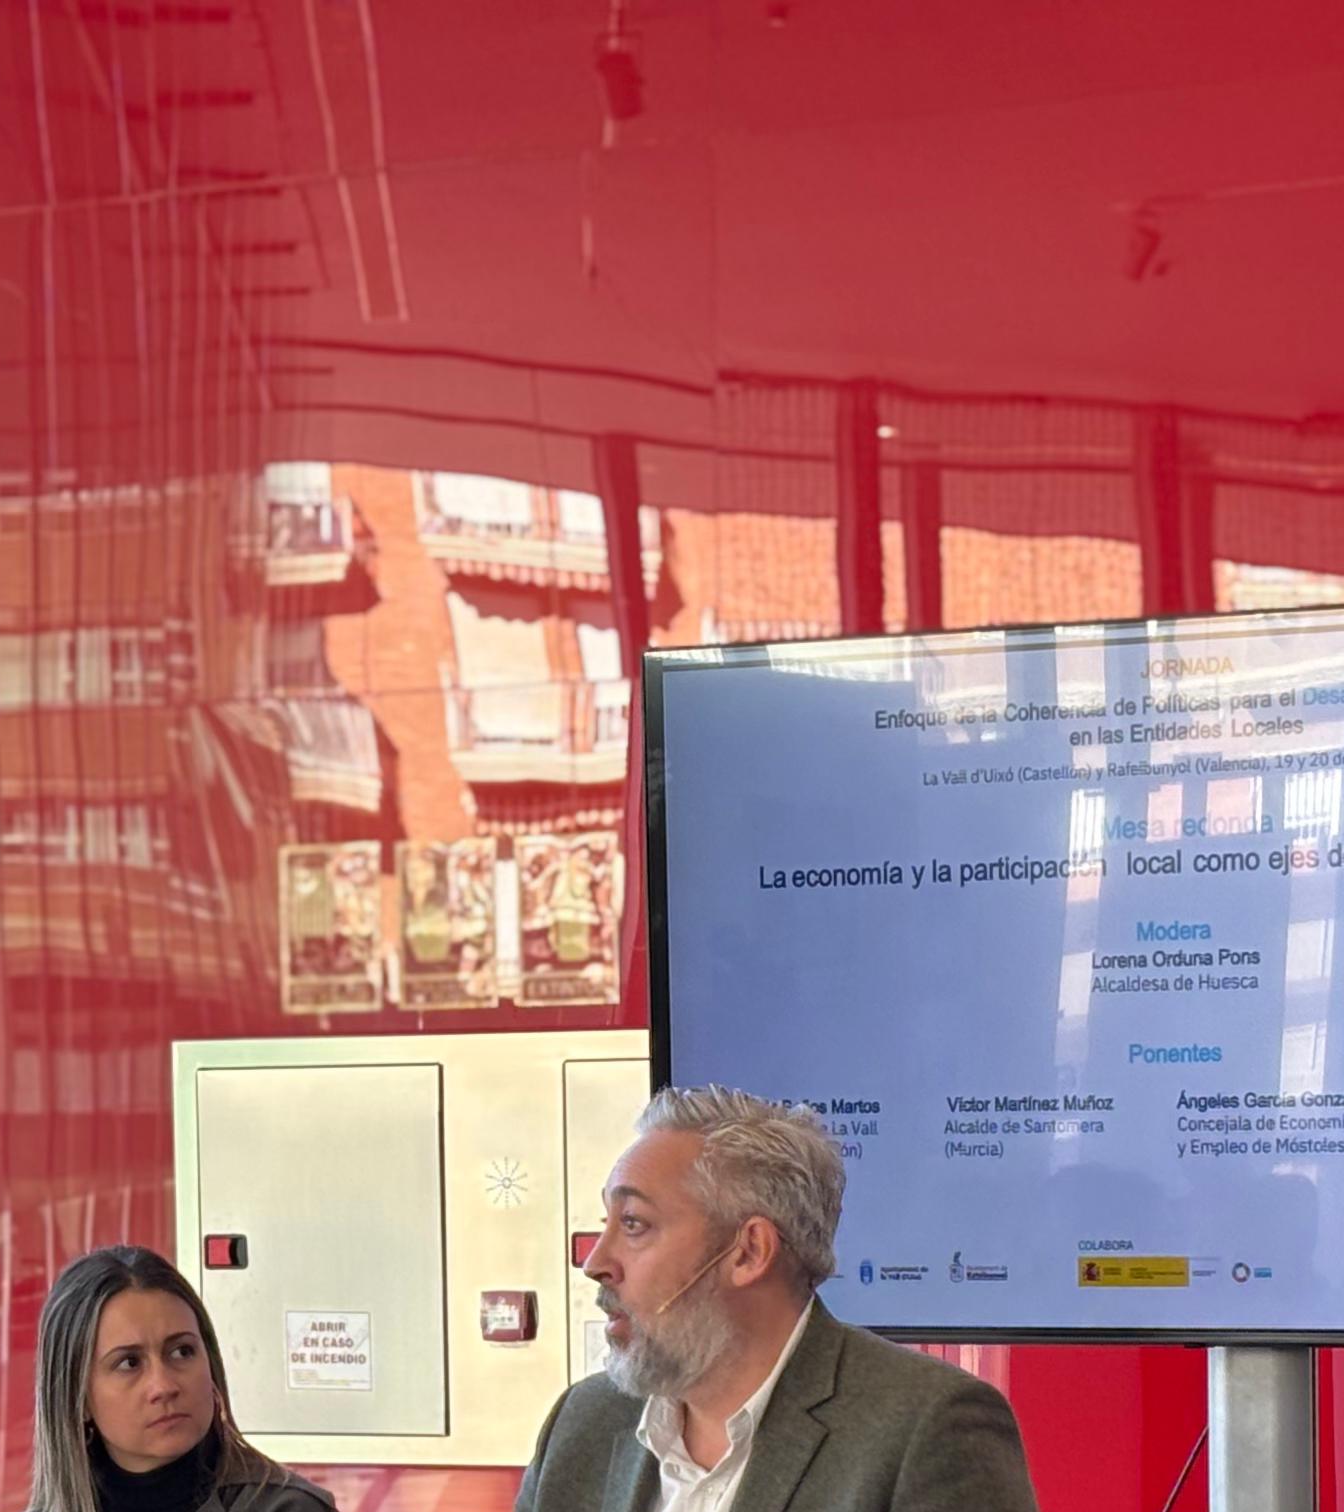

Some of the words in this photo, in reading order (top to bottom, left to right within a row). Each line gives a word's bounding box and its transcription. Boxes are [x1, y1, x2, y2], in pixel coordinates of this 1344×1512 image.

[1141, 656, 1234, 679] JORNADA
[875, 709, 947, 731] Enfoque
[1005, 699, 1106, 722] Coherencia
[1114, 697, 1136, 716] de
[1230, 691, 1272, 711] para
[1279, 688, 1297, 707] el
[1070, 730, 1092, 746] en
[1098, 726, 1124, 745] las
[1130, 720, 1222, 743] Entidades
[1231, 716, 1304, 738] Locales
[923, 772, 938, 786] La
[1096, 766, 1103, 783] y
[1276, 755, 1293, 769] 19
[1297, 758, 1306, 771] y
[1312, 753, 1329, 767] 20
[1105, 816, 1164, 840] Mesa
[759, 866, 786, 888] La
[792, 860, 903, 888] economía
[912, 864, 925, 889] y
[932, 859, 951, 883] la
[960, 851, 1106, 887] participación
[1128, 849, 1181, 875] local
[1193, 851, 1260, 873] como
[1268, 844, 1318, 876] ejes
[1136, 922, 1211, 941] Modera
[1093, 951, 1146, 969] Lorena
[1218, 948, 1260, 966] Pons
[1092, 974, 1169, 993] Alcaldesa
[1174, 974, 1194, 991] de
[1198, 972, 1258, 991] Huesca
[1128, 1043, 1223, 1064] Ponentes
[831, 1098, 881, 1115] Martos
[947, 1096, 990, 1113] Víctor
[994, 1095, 1060, 1113] Martínez
[1063, 1094, 1114, 1112] Muñoz
[1176, 1089, 1240, 1113] Ángeles
[1244, 1090, 1296, 1109] García
[851, 1120, 879, 1136] Vall
[944, 1119, 998, 1135] Alcalde
[1002, 1119, 1021, 1135] de
[1024, 1118, 1104, 1135] Santomera
[1177, 1115, 1252, 1135] Concejala
[1256, 1115, 1276, 1131] de
[944, 1141, 1004, 1159] (Murcia)
[1177, 1142, 1187, 1158] y
[1190, 1137, 1248, 1157] Empleo
[1252, 1138, 1272, 1154] de
[1078, 1239, 1134, 1251] COLABORA
[311, 1321, 346, 1332] ABRIR
[303, 1337, 319, 1348] EN
[323, 1337, 354, 1349] CASO
[291, 1353, 306, 1364] DE
[310, 1353, 367, 1365] INCENDIO
